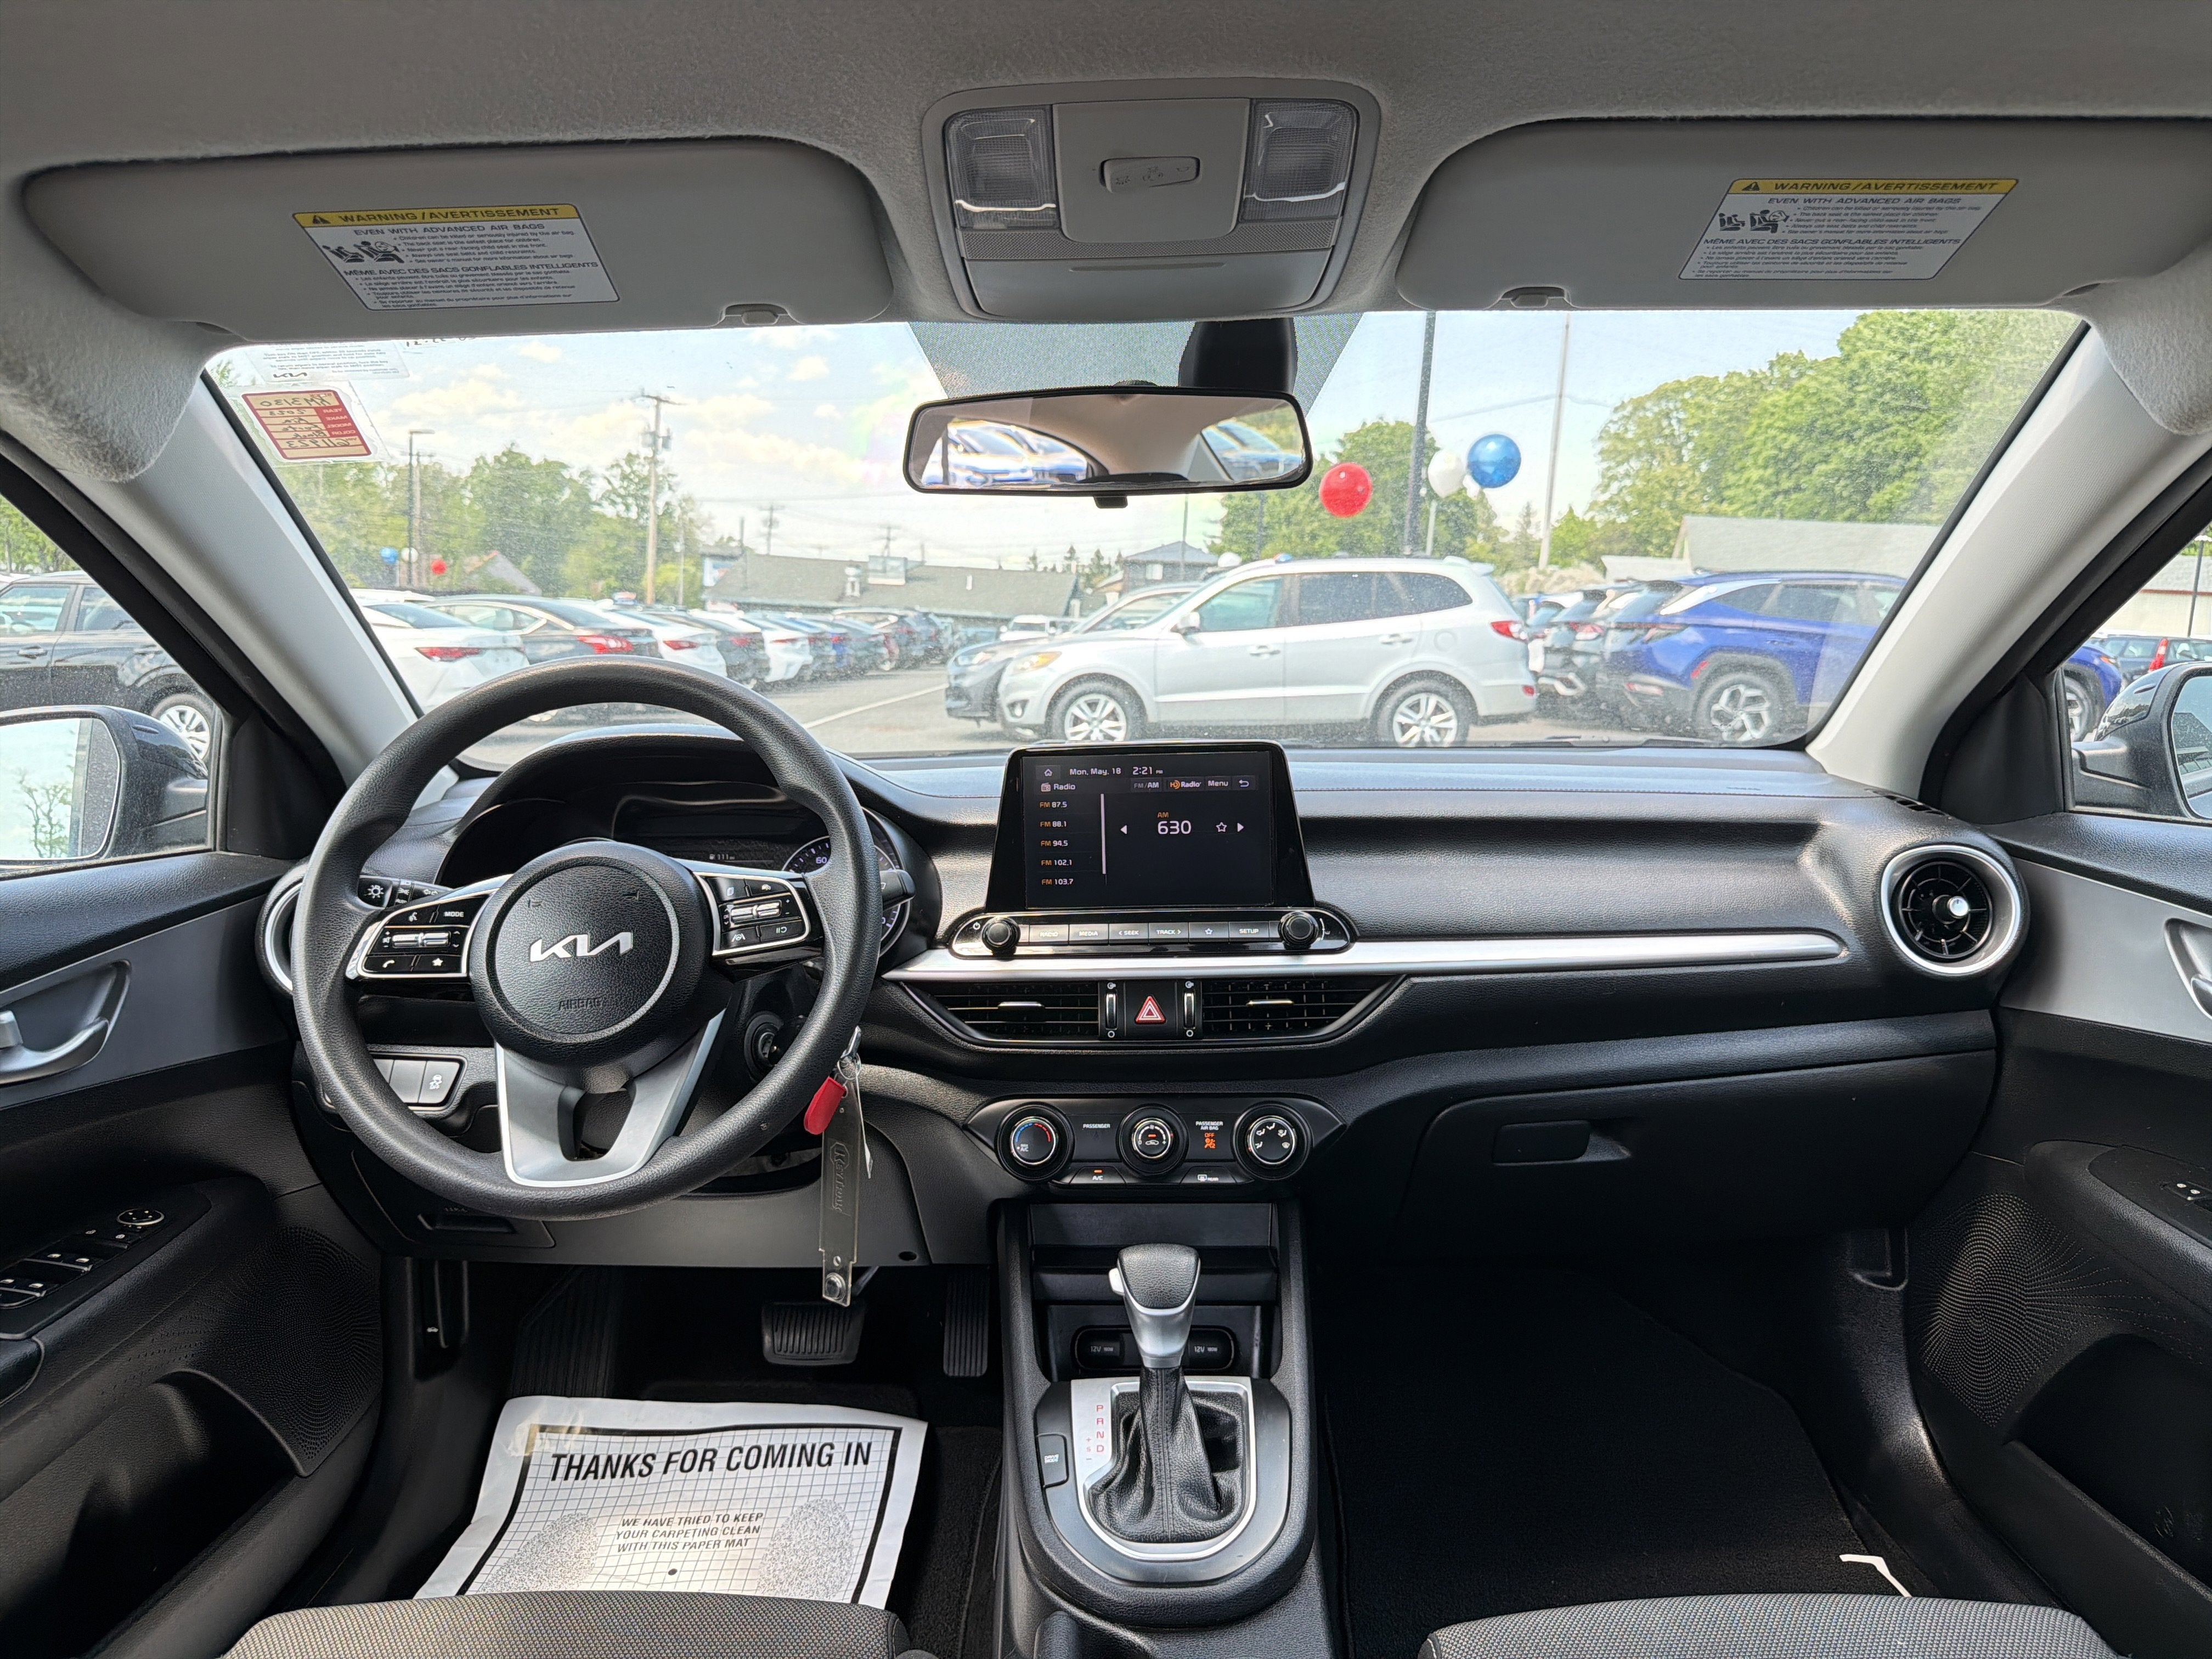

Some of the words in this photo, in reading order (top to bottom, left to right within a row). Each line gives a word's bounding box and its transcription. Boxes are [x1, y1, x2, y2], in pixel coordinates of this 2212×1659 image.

[338, 212, 417, 222] WARNING
[430, 208, 558, 219] AVERTISSEMENT
[1158, 820, 1191, 834] 630
[558, 997, 603, 1010] AIRBAG
[550, 1453, 656, 1482] THANKS
[663, 1448, 718, 1475] FOR
[725, 1442, 836, 1471] COMING
[844, 1441, 872, 1466] IN
[621, 1517, 640, 1527] WE
[643, 1516, 674, 1526] HAVE
[678, 1514, 713, 1525] TRIED
[716, 1513, 730, 1523] TO
[733, 1513, 764, 1522] KEEP
[616, 1528, 648, 1540] YOUR
[651, 1527, 719, 1538] CARPETING
[722, 1525, 761, 1535] CLEAN
[617, 1542, 647, 1552] WITH
[649, 1541, 679, 1550] THIS
[682, 1539, 721, 1549] PAPER
[724, 1538, 749, 1548] MAT
